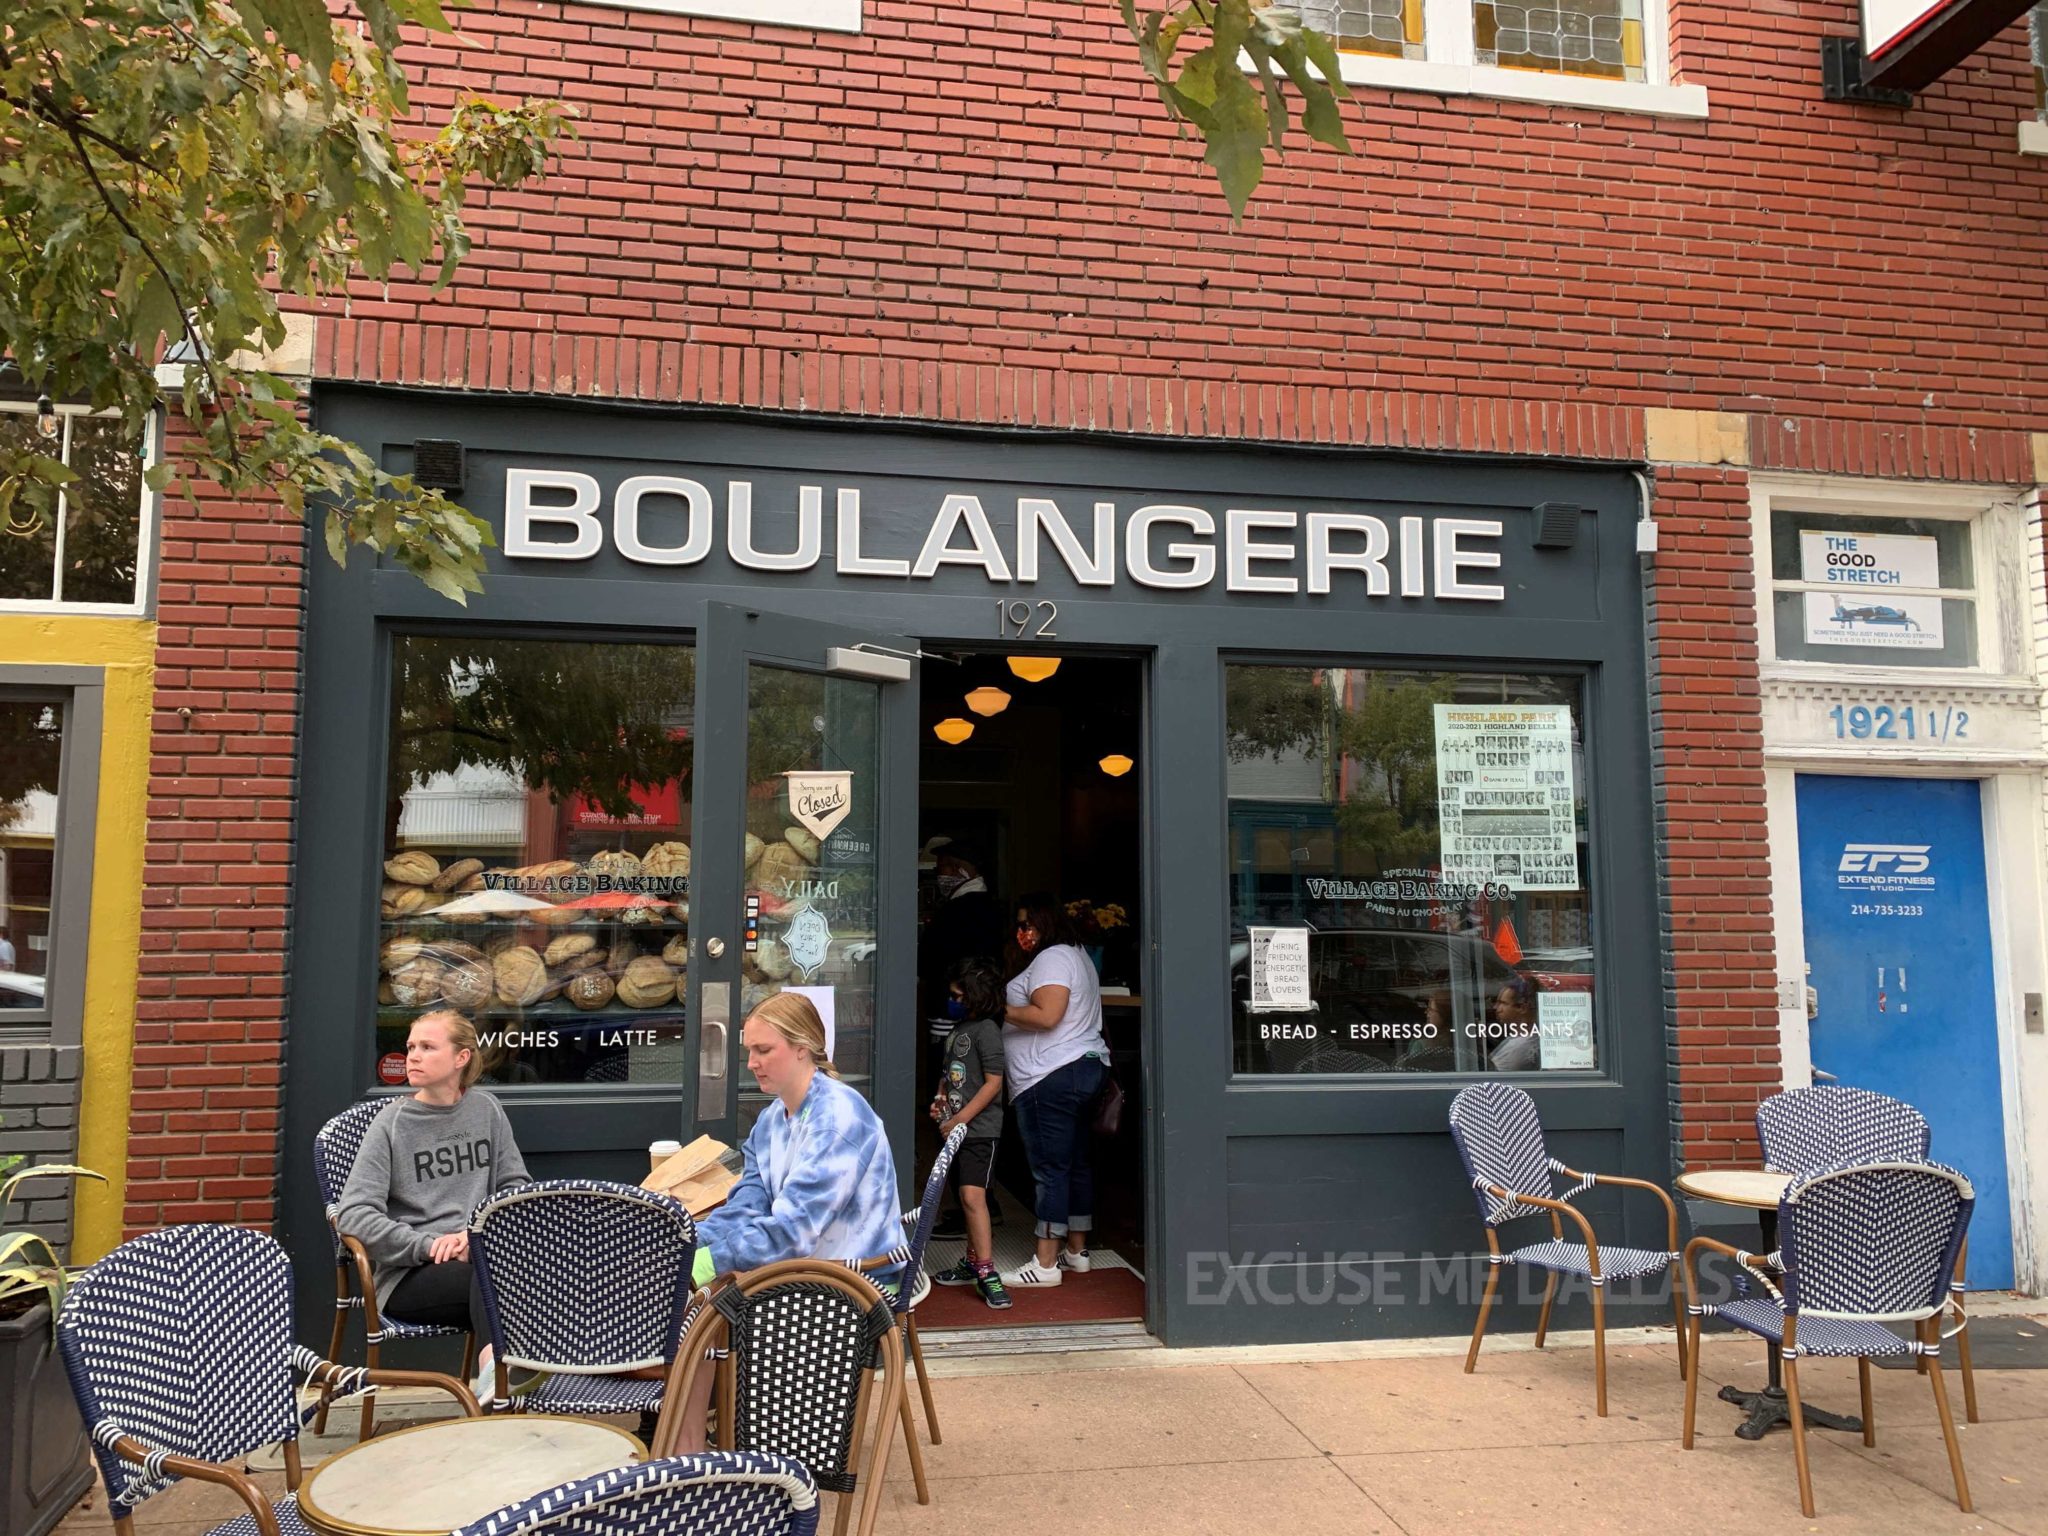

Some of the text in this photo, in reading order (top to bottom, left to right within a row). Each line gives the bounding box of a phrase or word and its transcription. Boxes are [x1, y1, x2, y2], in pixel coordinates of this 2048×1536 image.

[504, 468, 1505, 601] BOULANGERIE
[1825, 537, 1857, 551] THE
[1826, 552, 1876, 567] GOOD
[1827, 568, 1900, 584] STRETCH
[997, 600, 1057, 637] 192
[1447, 712, 1557, 723] HIGHLAND PARK
[1829, 704, 1969, 743] 1921 1/2
[800, 782, 815, 793] Sorry
[798, 784, 844, 816] Closed
[481, 873, 689, 895] VILLAGE BAKING
[1838, 875, 1935, 885] EXTEND FITNESS
[1306, 879, 1399, 899] VILLAGE
[1400, 880, 1479, 900] BAKING
[1365, 901, 1463, 917] PAINS AU CHOCOLAT
[1851, 904, 1923, 916] 214-735-3233
[1273, 943, 1299, 951] HIRING
[1266, 964, 1307, 972] ENERGETIC
[1274, 975, 1299, 983] BREAD
[1271, 986, 1302, 994] LOVERS
[600, 1030, 657, 1047] LATTE
[1260, 1024, 1318, 1040] BREAD
[1350, 1024, 1438, 1039] ESPRESSO
[1465, 1023, 1575, 1039] CROISSANTS
[414, 1138, 491, 1183] RSHQ
